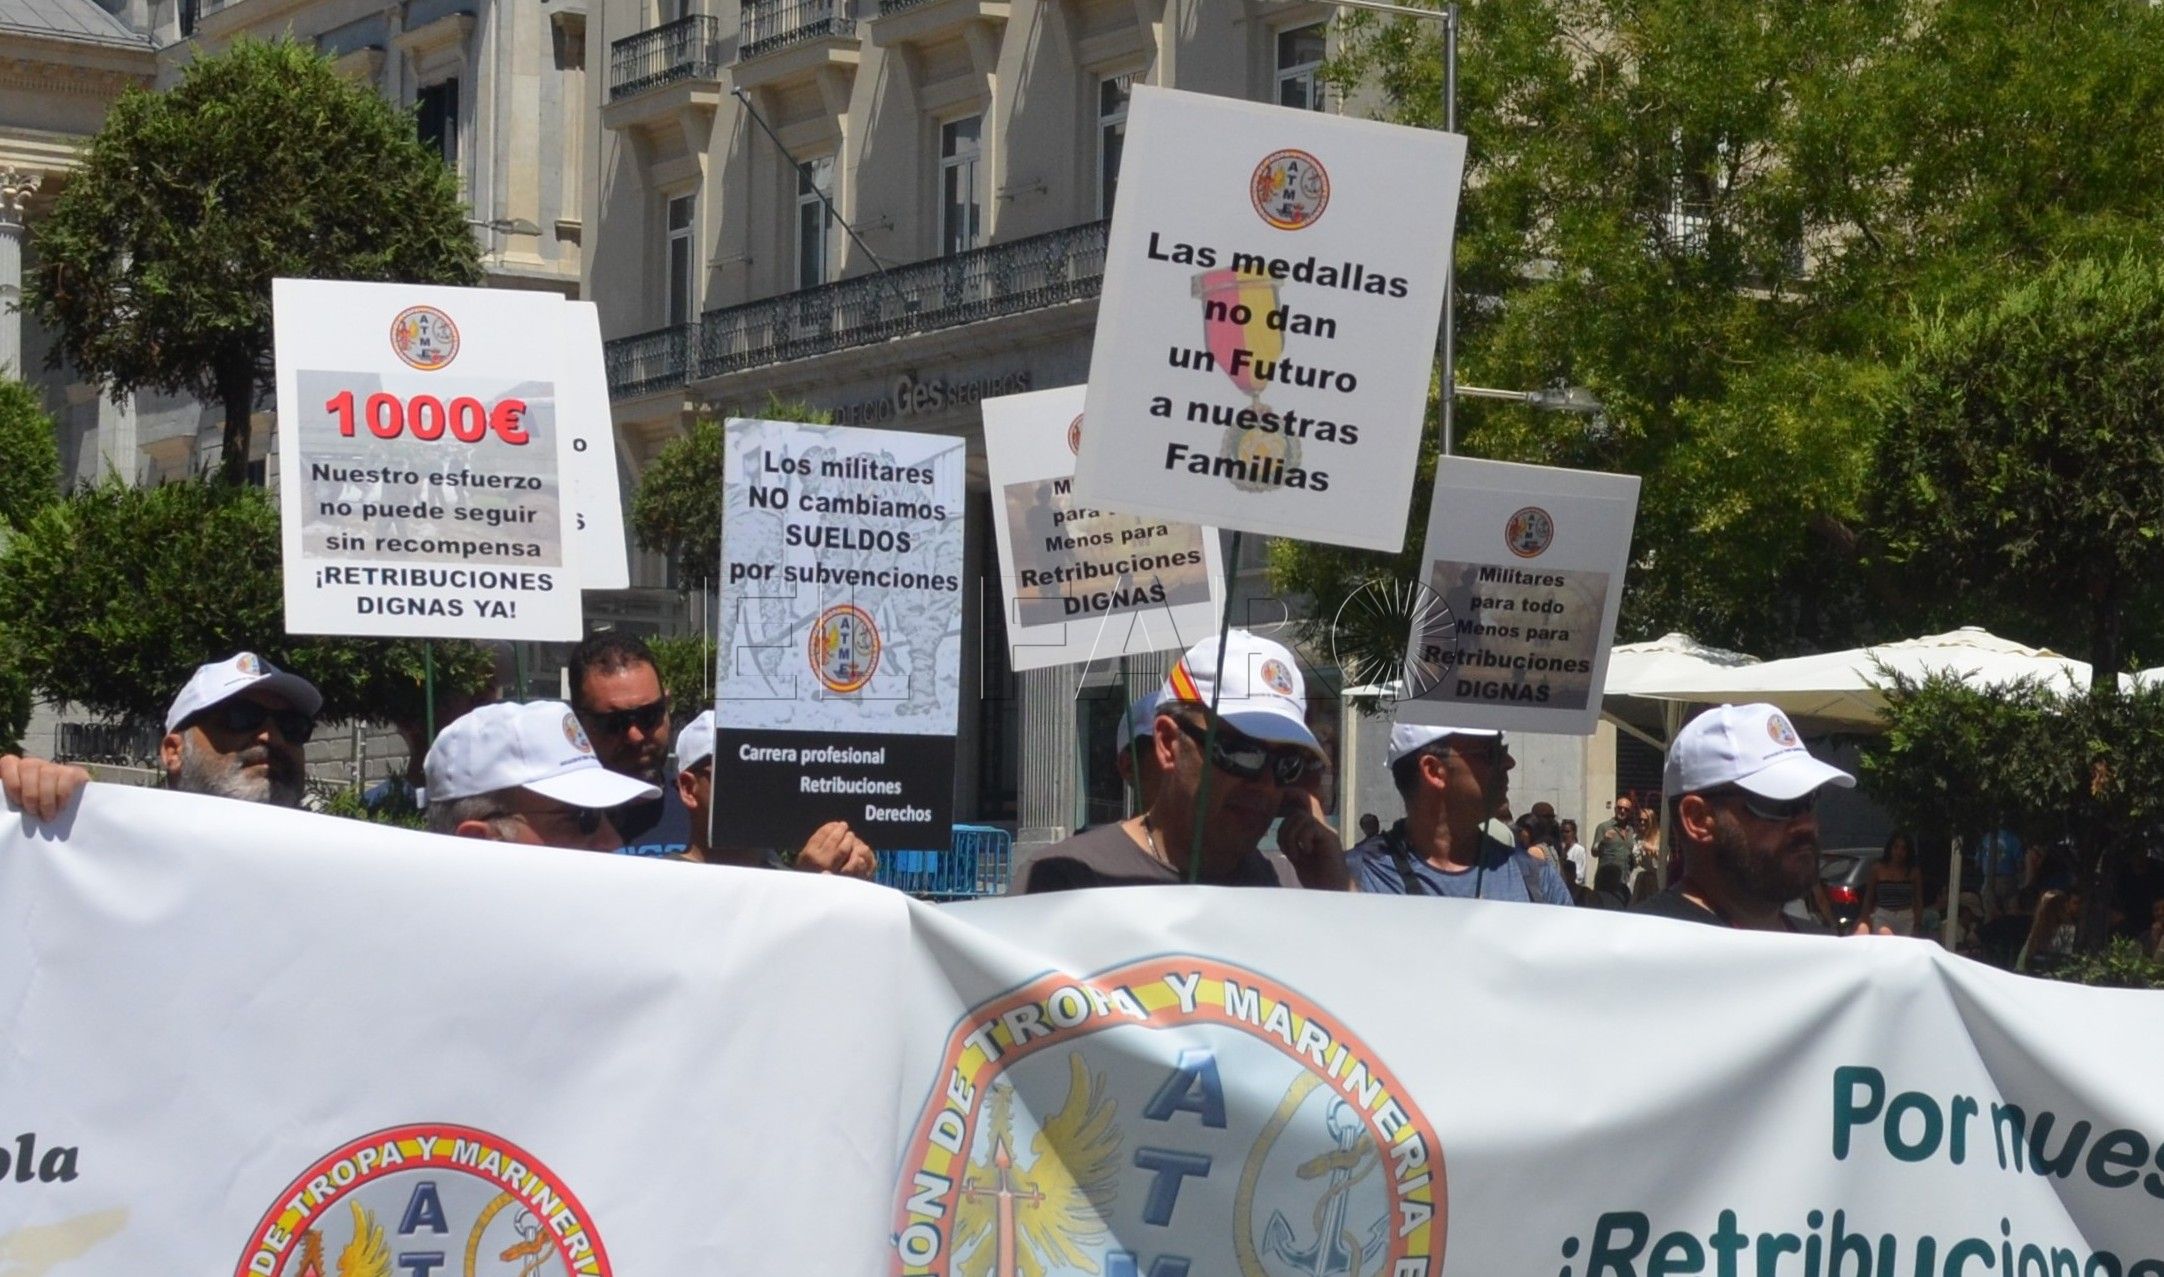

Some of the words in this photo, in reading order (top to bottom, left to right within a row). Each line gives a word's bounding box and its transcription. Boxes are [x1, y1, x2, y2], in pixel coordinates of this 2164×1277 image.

[1148, 232, 1217, 268] Las
[1231, 251, 1409, 298] medallas
[1205, 299, 1251, 325] no
[1266, 304, 1337, 339] dan
[1168, 346, 1215, 373] un
[1230, 348, 1358, 393] Futuro
[893, 374, 945, 415] Ges
[949, 371, 1028, 406] SEGUROS
[325, 389, 530, 446] 1000€
[1149, 395, 1172, 417] a
[1186, 399, 1359, 445] nuestras
[311, 463, 419, 485] Nuestro
[429, 469, 543, 491] esfuerzo
[765, 451, 811, 475] Los
[821, 457, 935, 484] militares
[1165, 442, 1329, 492] Familias
[320, 501, 351, 517] no
[362, 501, 444, 522] puede
[454, 505, 537, 526] seguir
[749, 486, 789, 509] NO
[799, 494, 947, 521] cambiamos
[1053, 508, 1100, 527] para
[326, 534, 366, 551] sin
[375, 538, 542, 559] recompensa
[786, 524, 912, 553] SUELDOS
[1045, 531, 1114, 552] Menos
[1121, 524, 1168, 545] para
[315, 566, 554, 592] ¡RETRIBUCIONES
[730, 562, 775, 584] por
[784, 562, 959, 592] subvenciones
[1021, 550, 1201, 588] Retribuciones
[1479, 567, 1565, 587] Militares
[357, 596, 464, 617] DIGNAS
[473, 600, 517, 619] YA!
[1063, 584, 1166, 615] DIGNAS
[1470, 596, 1513, 611] para
[1522, 596, 1564, 614] todo
[1456, 619, 1519, 637] Menos
[1526, 627, 1570, 642] para
[1424, 645, 1590, 673] Retribuciones
[1456, 680, 1550, 703] DIGNAS
[739, 744, 797, 762] Carrera
[801, 745, 885, 767] profesional
[800, 776, 901, 794] Retribuciones
[865, 804, 931, 822] Derechos
[889, 1169, 953, 1277] ÓN
[930, 1068, 978, 1155] DE
[963, 984, 1151, 1066] TROPA
[1164, 972, 1201, 1014] Y
[1222, 979, 1435, 1240] MARINERIA
[1832, 1065, 1978, 1166] Por
[248, 1223, 293, 1277] DE
[285, 1140, 403, 1219] TROPA
[416, 1135, 438, 1161] Y
[451, 1137, 602, 1277] MARINERI
[1559, 1208, 2164, 1277] ¡Retribuci
